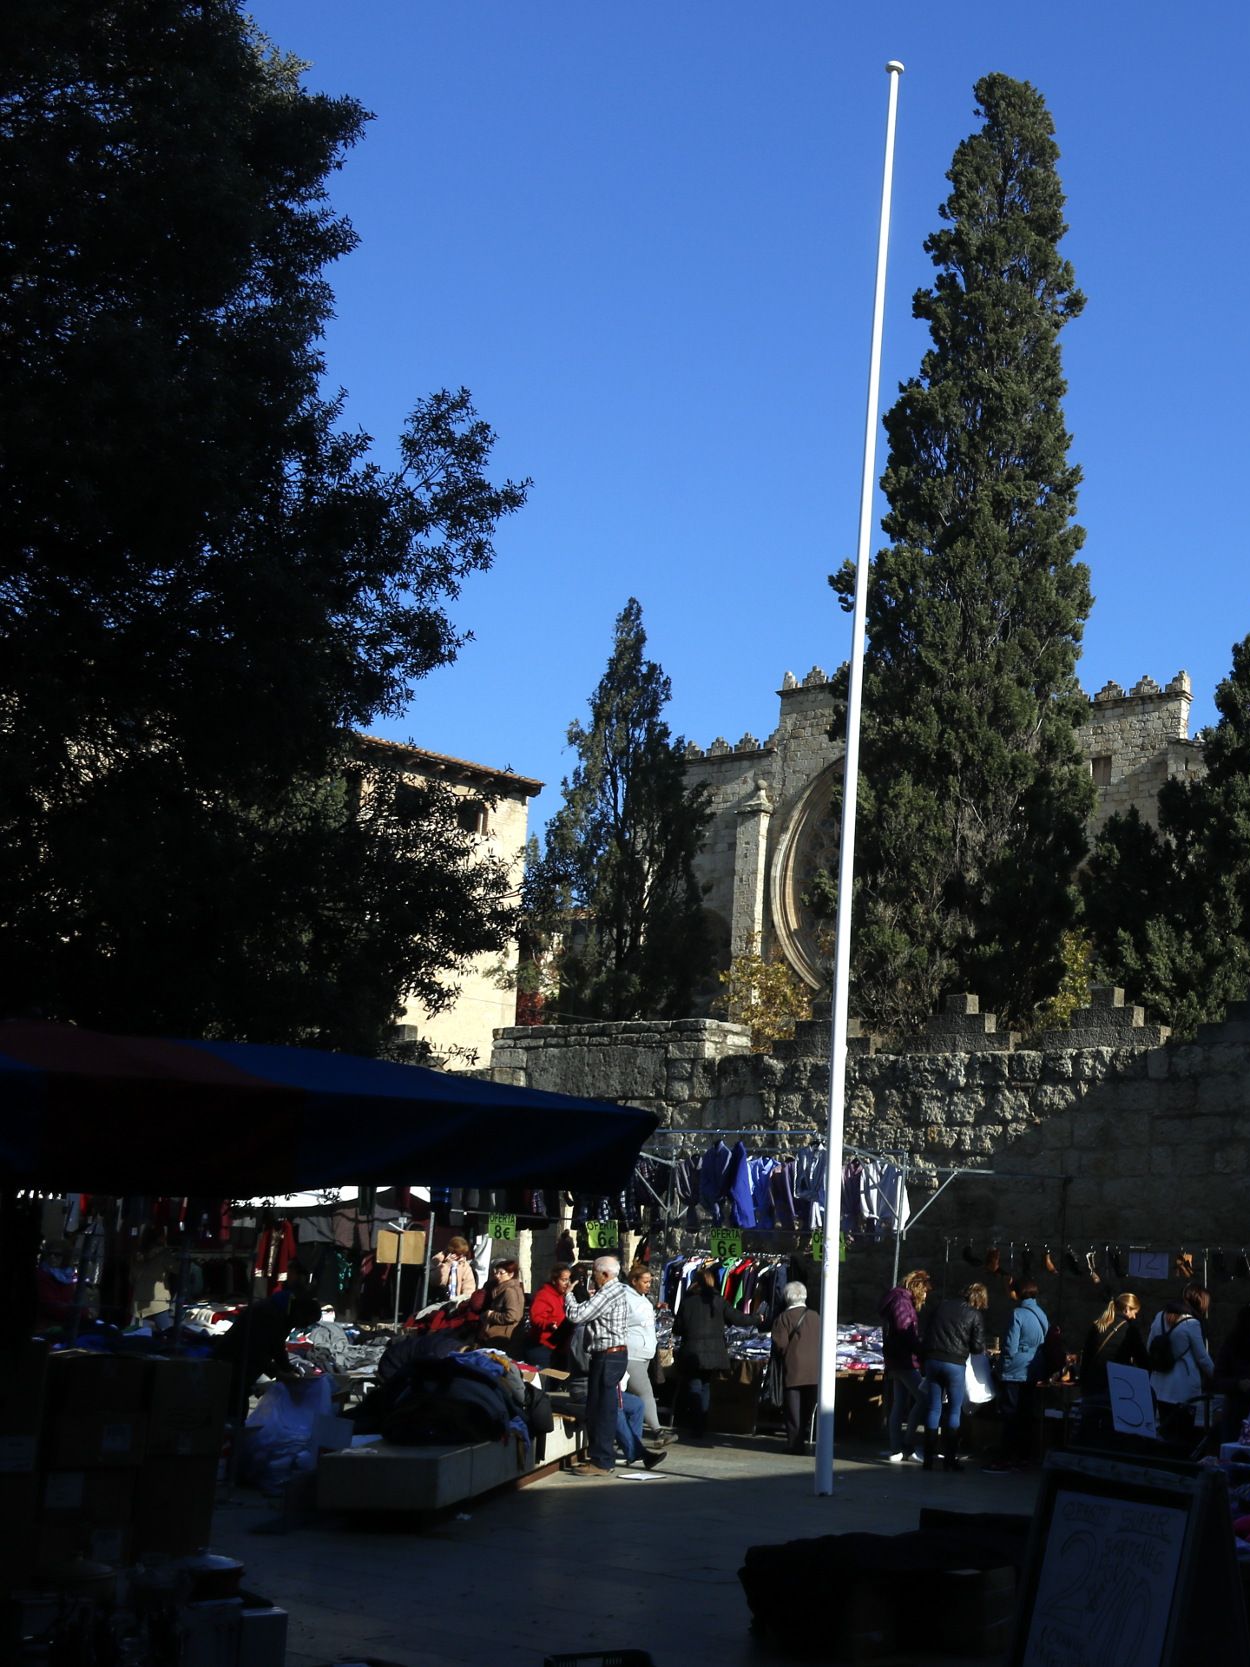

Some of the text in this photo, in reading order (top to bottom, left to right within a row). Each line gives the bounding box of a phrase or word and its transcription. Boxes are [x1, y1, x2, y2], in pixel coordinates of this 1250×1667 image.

[489, 1214, 515, 1224] OFERTA
[586, 1221, 617, 1231] OFERTA
[494, 1225, 511, 1240] 8€
[597, 1231, 616, 1247] 6€
[710, 1229, 740, 1239] OFERTA
[717, 1240, 737, 1257] 6€
[1137, 1252, 1160, 1272] 12
